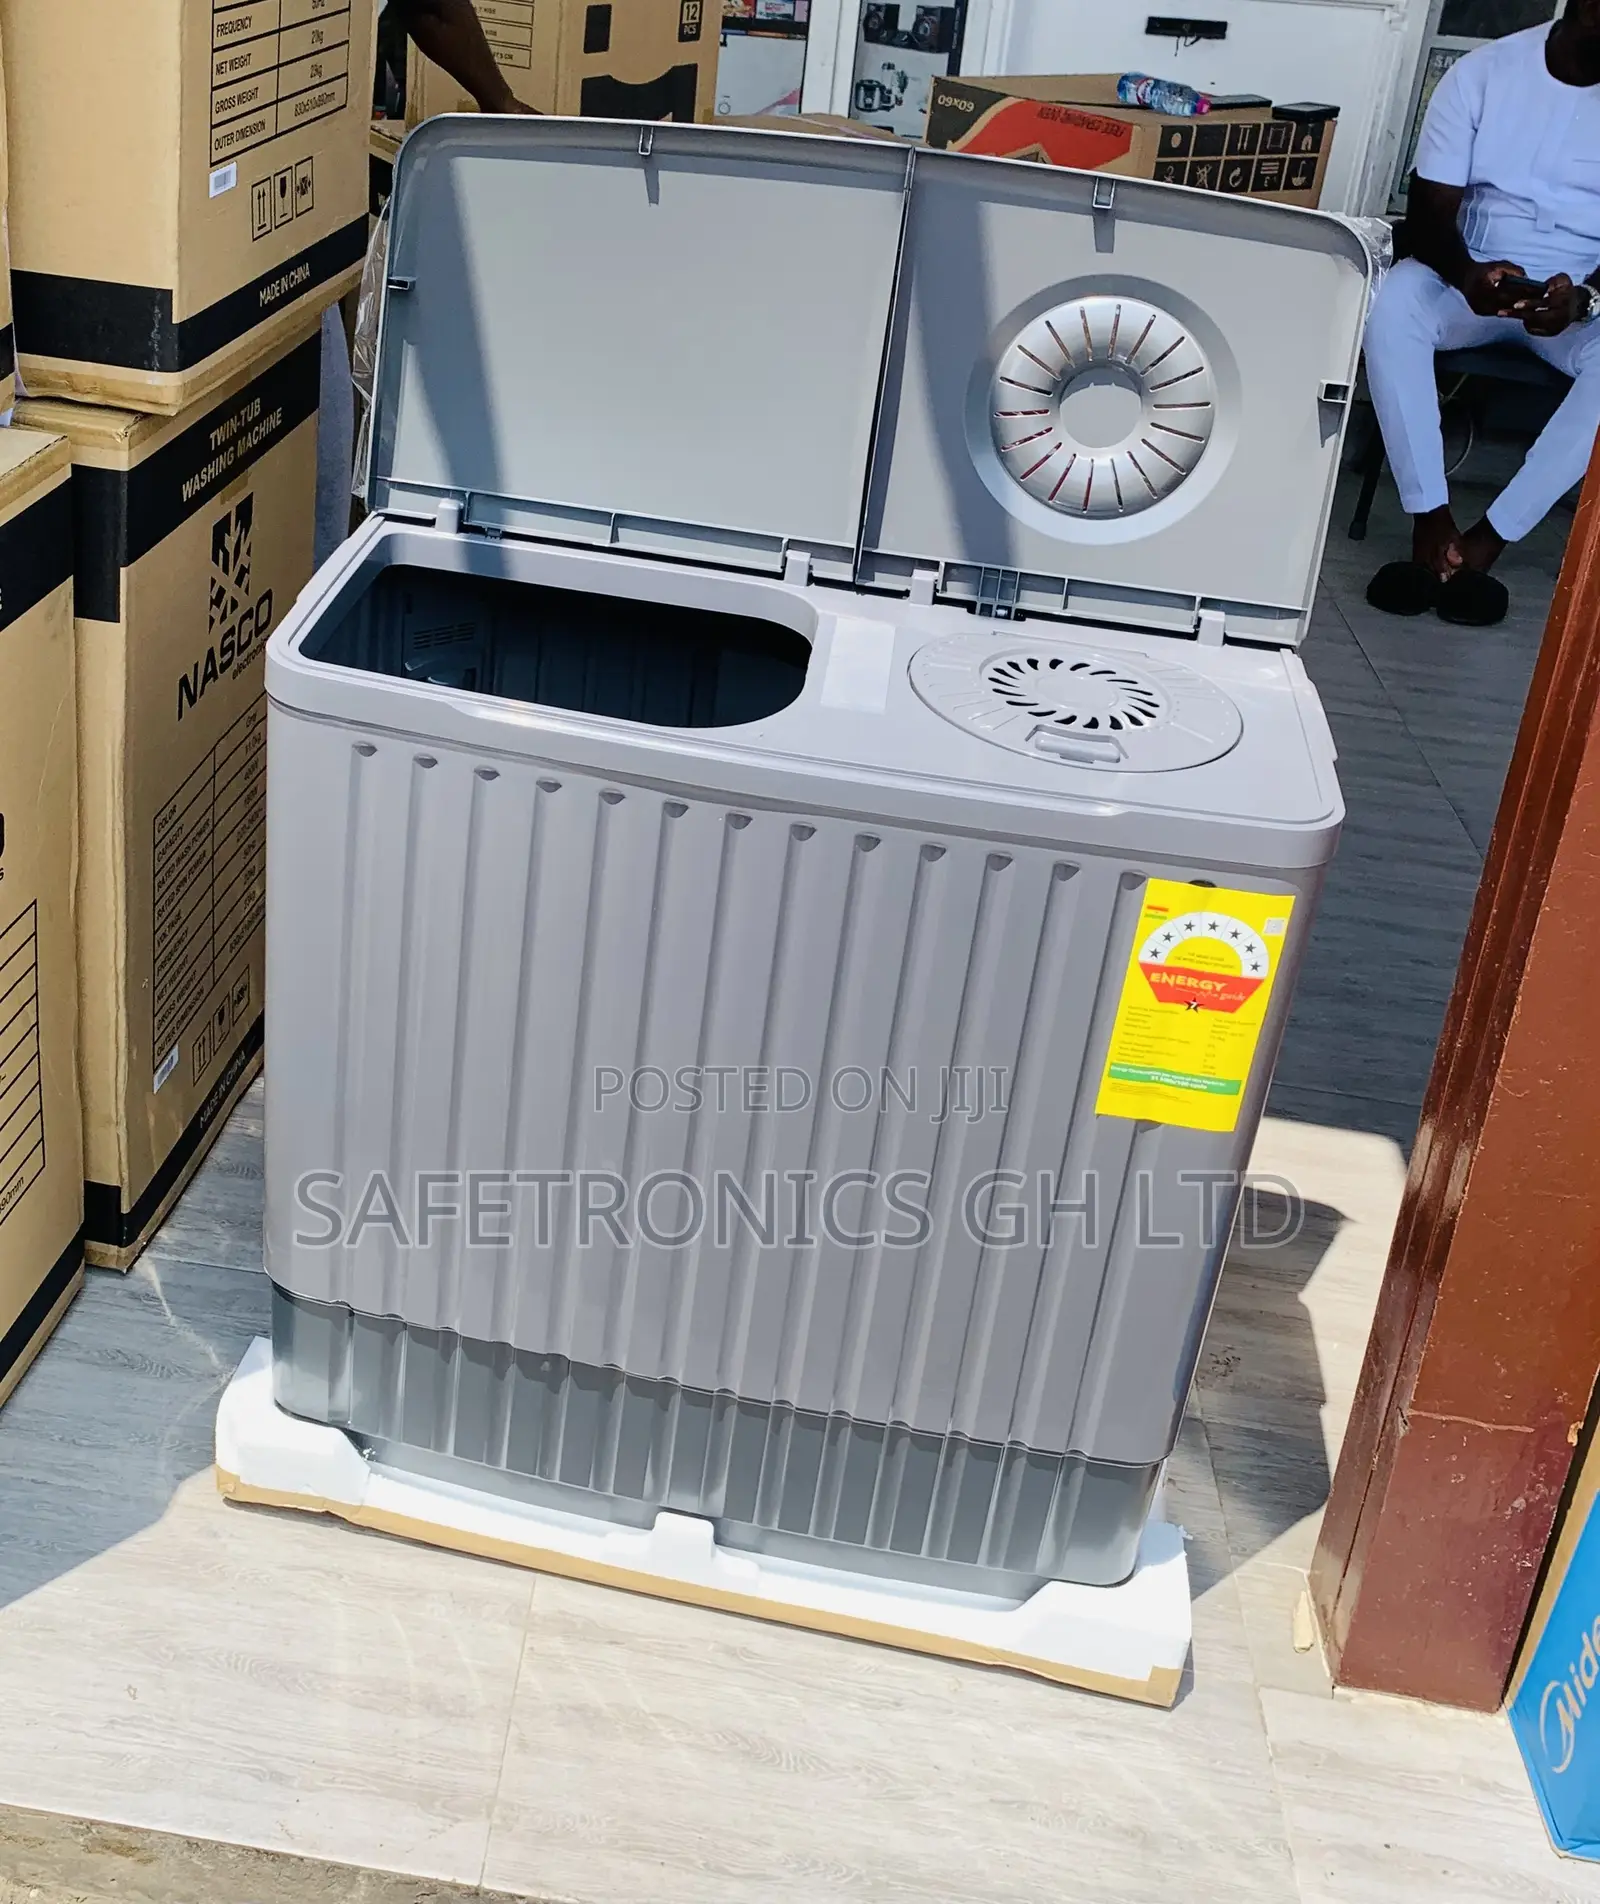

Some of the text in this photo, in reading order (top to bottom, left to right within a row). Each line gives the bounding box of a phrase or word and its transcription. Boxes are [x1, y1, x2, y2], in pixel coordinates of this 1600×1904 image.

[685, 2, 699, 21] 12
[215, 15, 253, 38] FREQUENCY
[683, 24, 697, 35] PCS
[215, 53, 252, 76] NET WEIGHT
[214, 87, 259, 114] GROSS WEIGHT
[214, 119, 266, 151] OUTER DIMENSION
[259, 262, 311, 308] MADE IN CHINA
[209, 397, 261, 451] TWIN-TUB
[182, 407, 283, 503] WASHING MACHINE
[178, 588, 273, 722] NASCO
[1149, 972, 1228, 992] ENERGY
